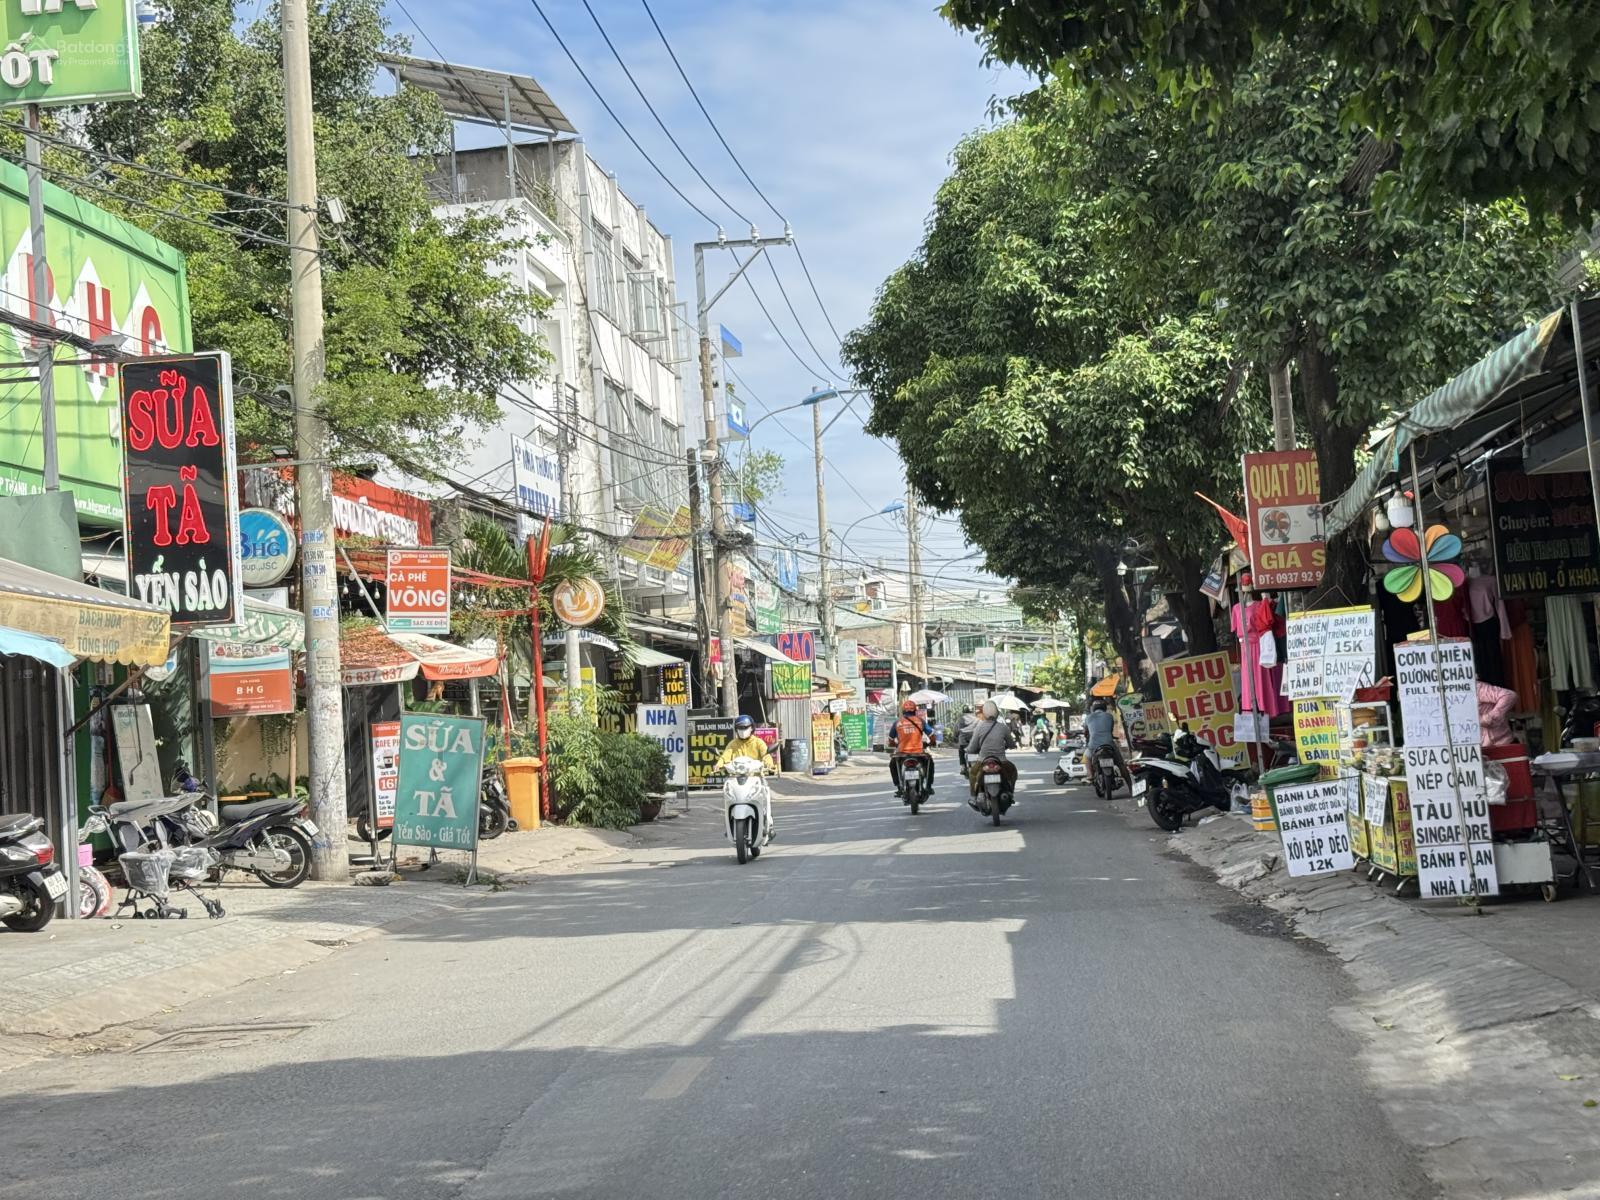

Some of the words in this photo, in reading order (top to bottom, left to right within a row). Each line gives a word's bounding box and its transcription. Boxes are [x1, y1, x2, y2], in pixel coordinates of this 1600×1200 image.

[129, 369, 220, 451] SỮA
[1250, 463, 1289, 505] QUẠT
[146, 464, 210, 547] TÃ
[1260, 546, 1302, 570] GIÁ
[184, 556, 228, 612] SÀO
[407, 570, 427, 582] PHÊ
[1276, 571, 1299, 584] 0937
[1302, 570, 1313, 582] 92
[390, 585, 447, 608] VÕNG
[1334, 640, 1363, 654] 15K
[1296, 660, 1316, 675] BÁNH
[1397, 650, 1426, 667] CƠM
[1164, 658, 1226, 689] PHỤ
[1400, 668, 1439, 685] DƯƠNG
[1441, 663, 1474, 682] CHÂU
[664, 693, 688, 706] NAM
[1406, 686, 1428, 695] FULL
[646, 706, 677, 726] NHÀ
[1169, 690, 1235, 721] LIỆU
[405, 720, 475, 754] SỮA
[429, 759, 447, 782] &
[413, 785, 458, 819] TÃ
[1276, 790, 1304, 804] BÁNH
[1413, 799, 1453, 821] TÀU
[1282, 817, 1315, 831] BÁNH
[1287, 836, 1304, 861] XÔI
[1420, 849, 1456, 870] BÁNH
[1308, 858, 1334, 872] 12K
[1431, 876, 1457, 896] NHÀ
